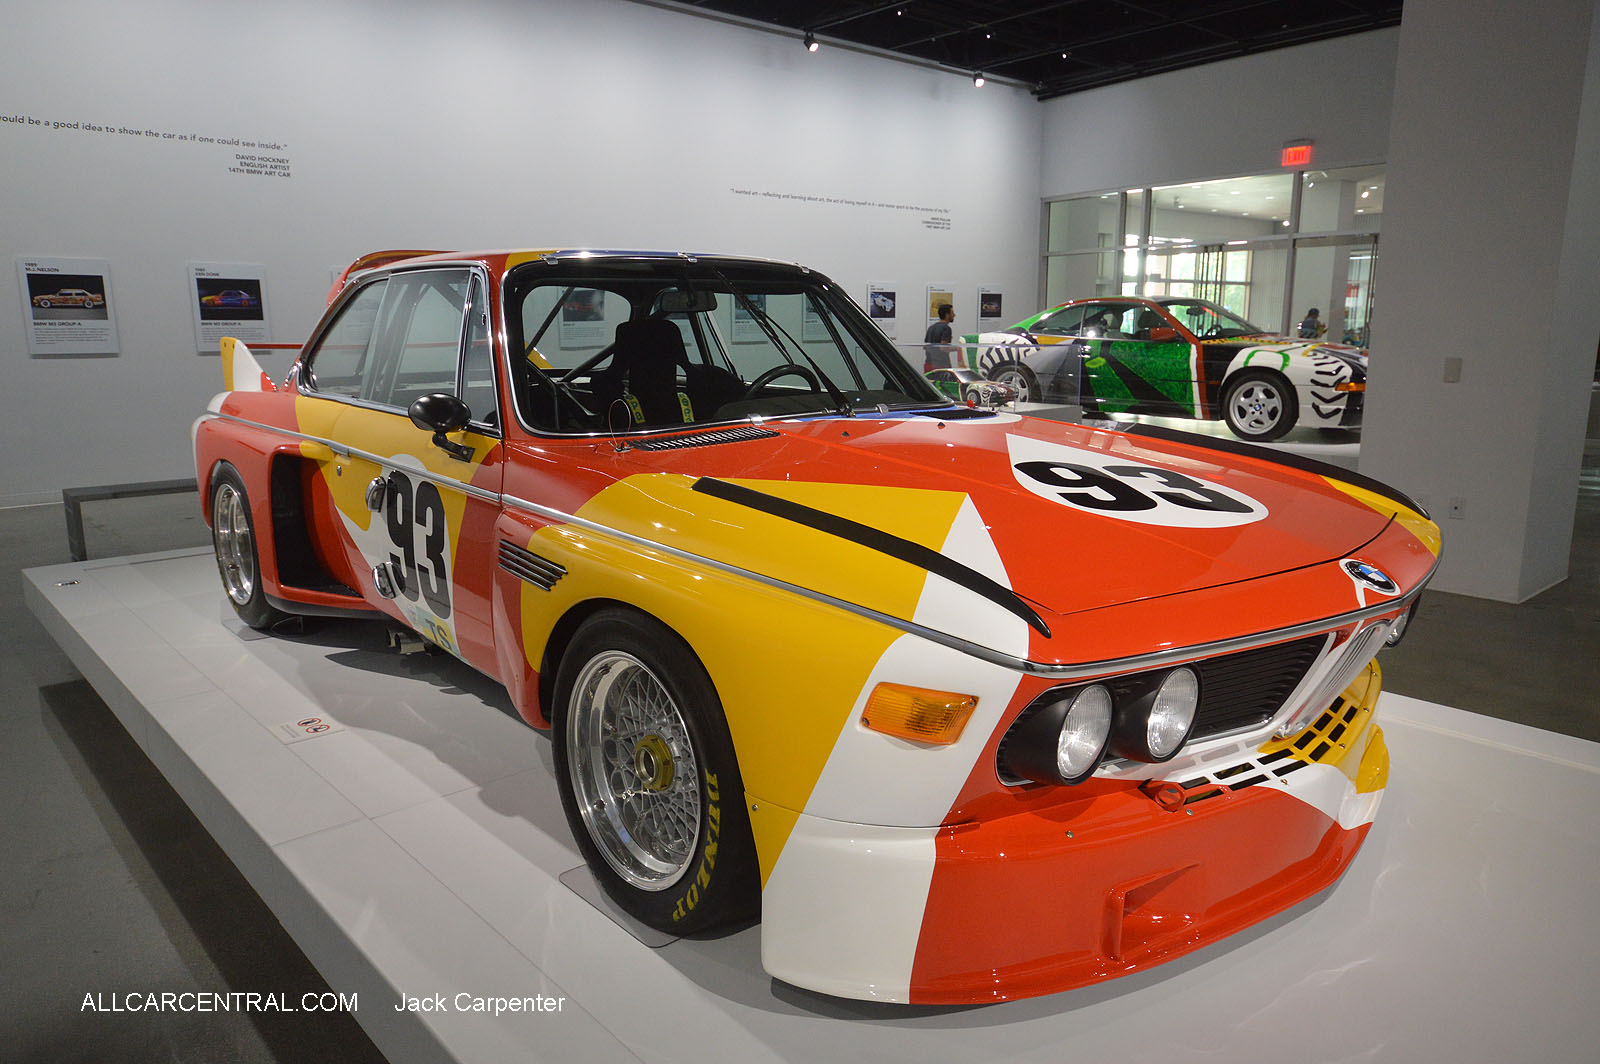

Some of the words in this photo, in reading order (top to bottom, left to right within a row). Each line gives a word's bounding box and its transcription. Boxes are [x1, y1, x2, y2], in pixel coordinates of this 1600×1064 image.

[28, 116, 41, 125] be
[53, 121, 79, 129] good
[82, 123, 103, 132] idea
[118, 127, 142, 136] show
[145, 129, 160, 137] the
[190, 133, 197, 141] if
[217, 138, 240, 146] could
[235, 153, 257, 162] DAVID
[258, 155, 290, 164] HOCKNEY
[240, 161, 268, 169] ENGLISH
[762, 191, 781, 199] reflecting
[1014, 461, 1254, 513] 93
[387, 470, 451, 620] 93
[424, 618, 452, 650] TS
[672, 768, 721, 922] DUNLOP
